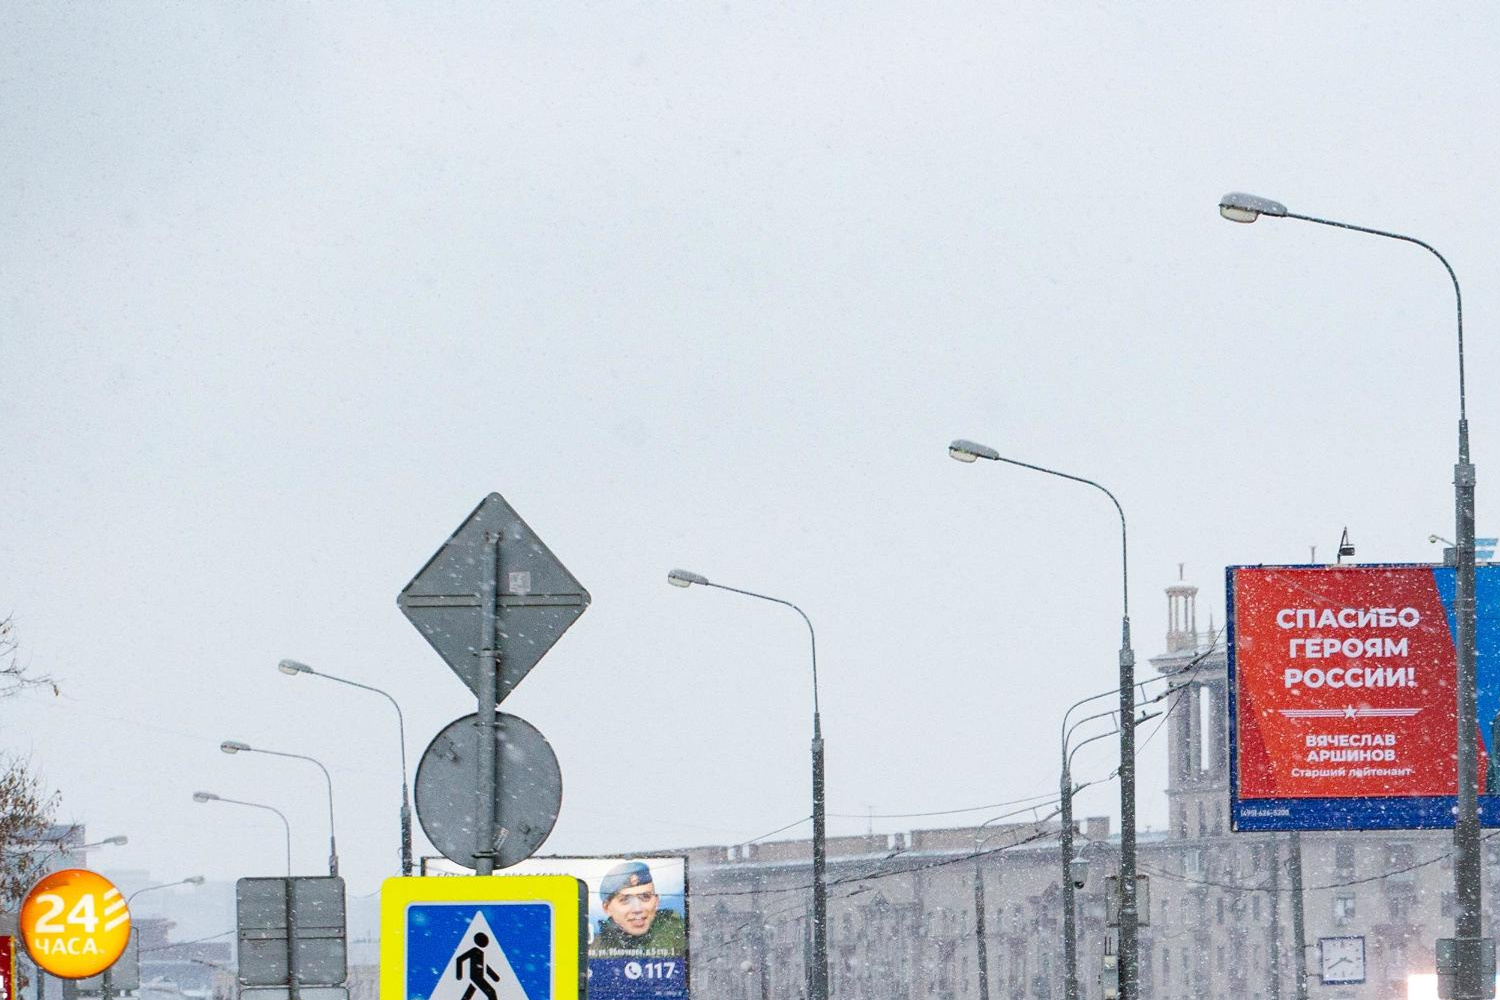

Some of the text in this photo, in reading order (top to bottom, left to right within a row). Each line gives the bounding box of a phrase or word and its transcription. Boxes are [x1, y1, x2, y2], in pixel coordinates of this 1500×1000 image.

[1276, 607, 1421, 629] СПАСИБО
[1289, 637, 1409, 659] ГЕРОЯМ
[1284, 667, 1418, 689] РОССИИ!
[1305, 734, 1396, 747] ВЯЧЕСЛАВ
[1307, 749, 1396, 762] АРШИНОВ
[1291, 766, 1412, 778] Старший лейтенант
[35, 893, 99, 933] 24
[35, 937, 98, 956] ЧАСА
[644, 961, 676, 979] 117
